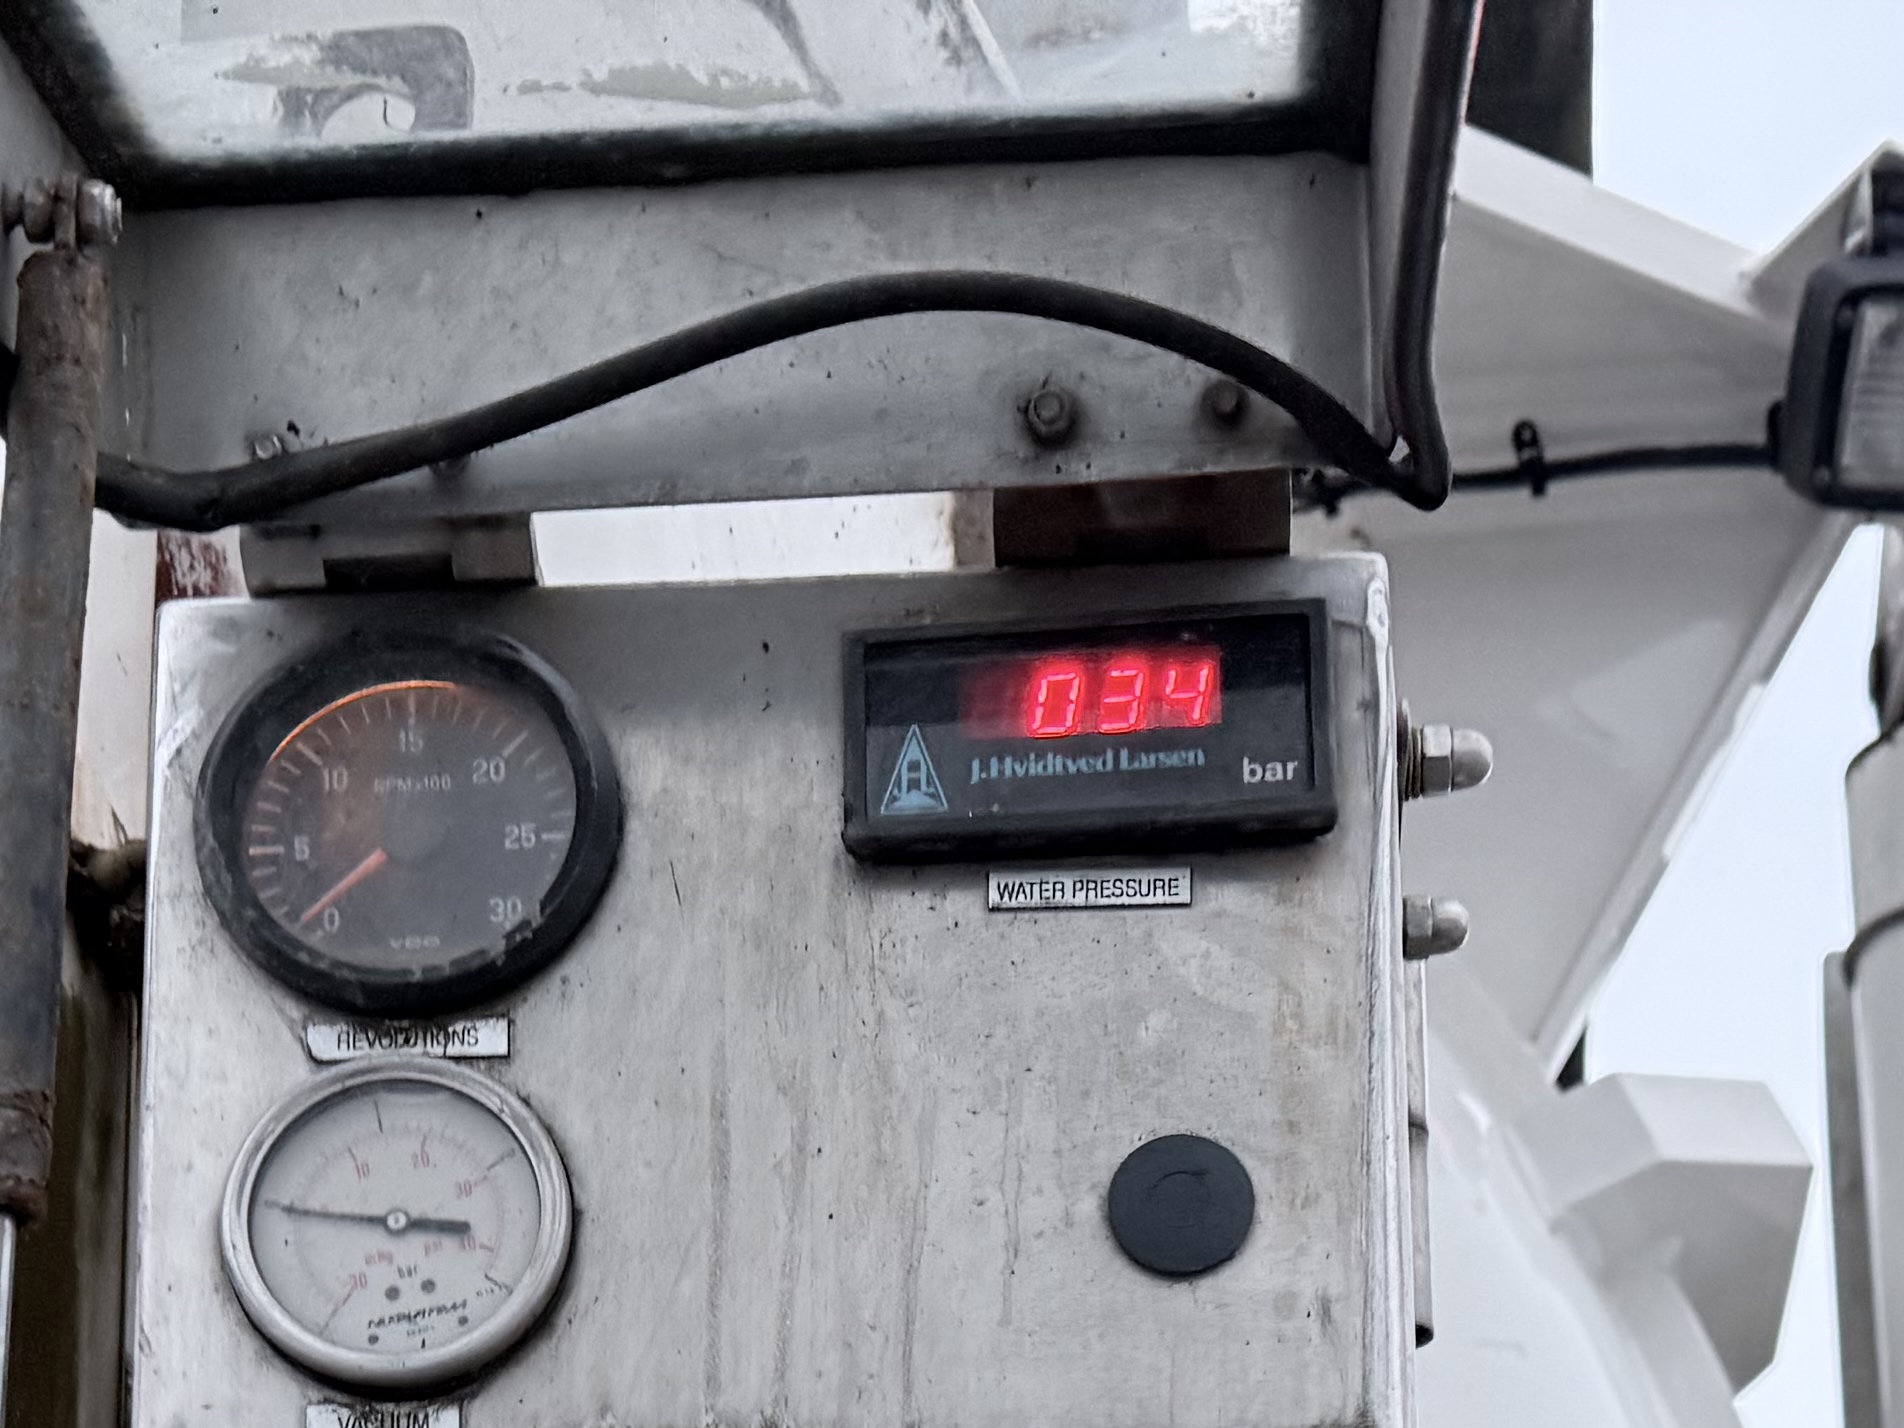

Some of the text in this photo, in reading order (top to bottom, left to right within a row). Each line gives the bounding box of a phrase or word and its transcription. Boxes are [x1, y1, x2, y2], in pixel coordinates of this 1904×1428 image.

[1031, 664, 1214, 737] 034
[398, 729, 424, 753] 15
[1119, 746, 1206, 770] Larsen
[1242, 755, 1299, 784] bar
[322, 767, 348, 790] 10
[472, 759, 506, 784] 20
[294, 837, 310, 861] 5
[504, 825, 537, 849] 25
[996, 876, 1181, 902] WATER PRESSURE
[323, 909, 340, 933] 0
[490, 898, 523, 922] 30
